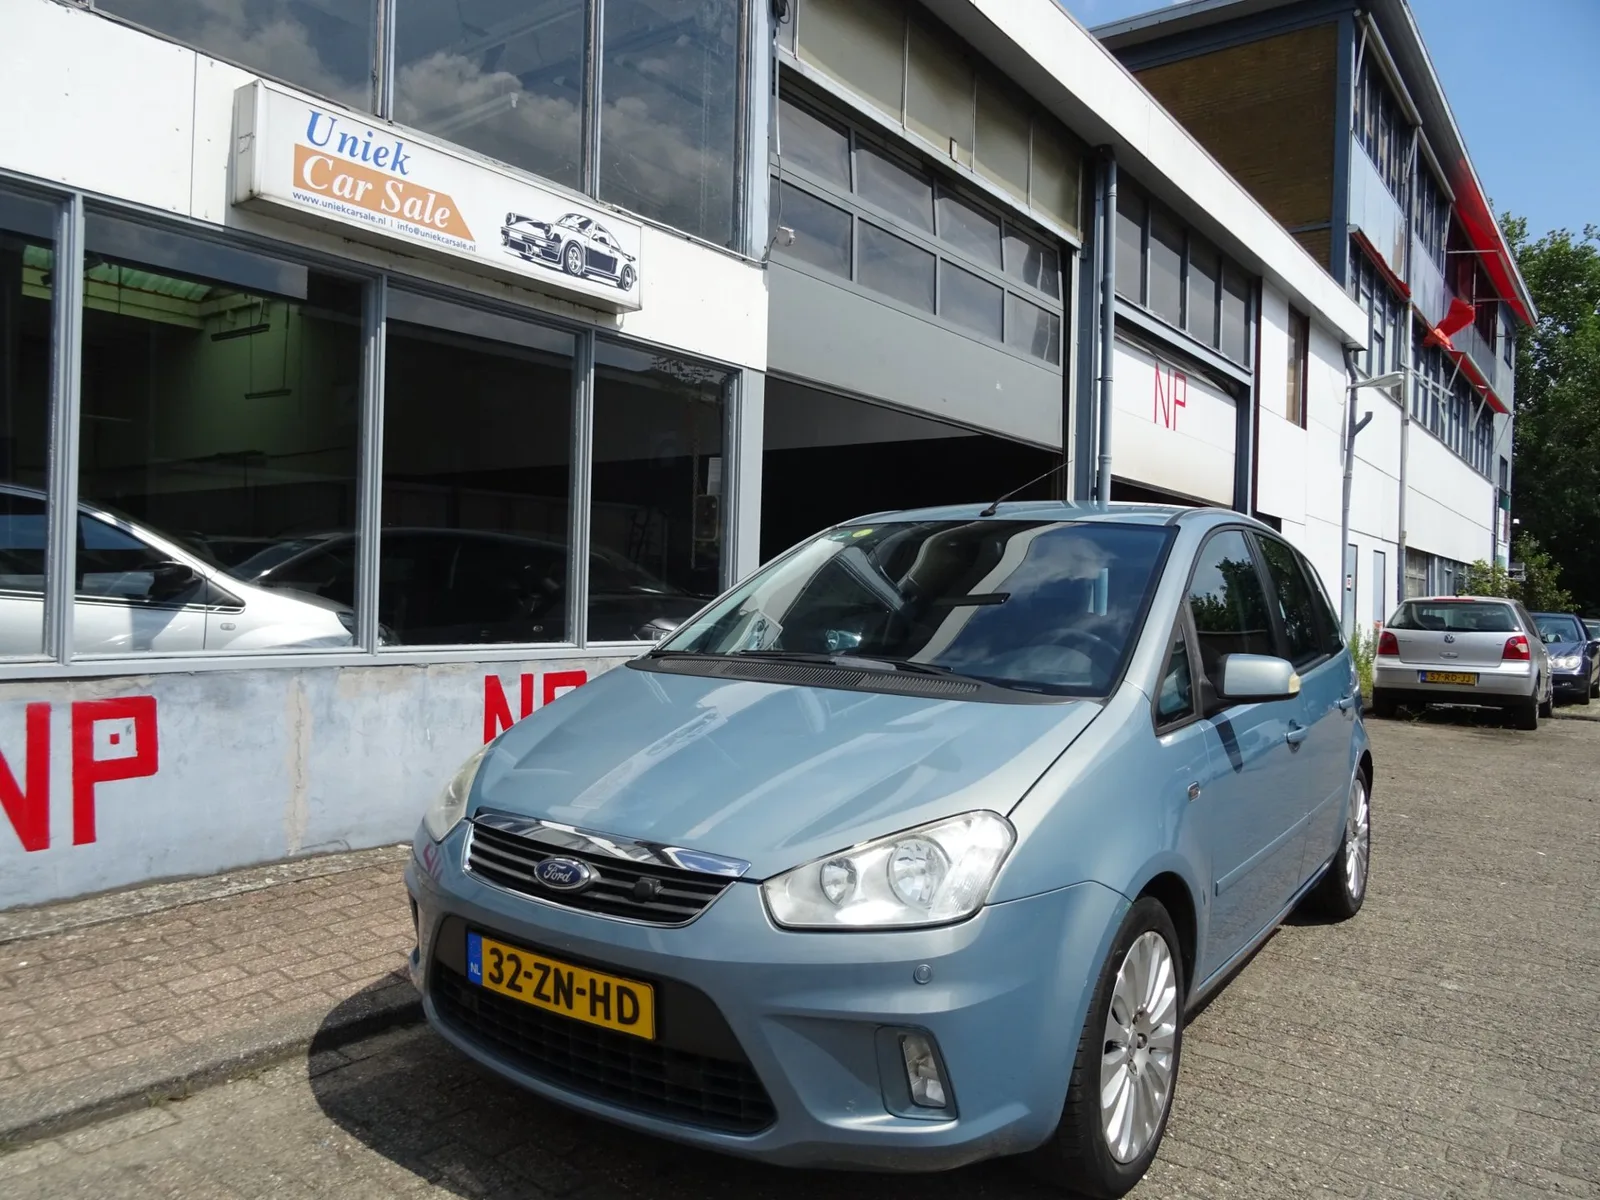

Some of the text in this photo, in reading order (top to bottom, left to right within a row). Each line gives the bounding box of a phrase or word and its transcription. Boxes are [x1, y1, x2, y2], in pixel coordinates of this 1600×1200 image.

[306, 109, 411, 176] Uniek
[292, 192, 387, 225] www.uniekcarsale.nl
[396, 221, 477, 253] info@uniekcarsale.nl
[303, 155, 451, 228] Car Sale
[1154, 361, 1187, 431] NP
[543, 861, 572, 883] Ford
[470, 961, 481, 976] NL
[488, 948, 640, 1025] 32-ZN-HD
